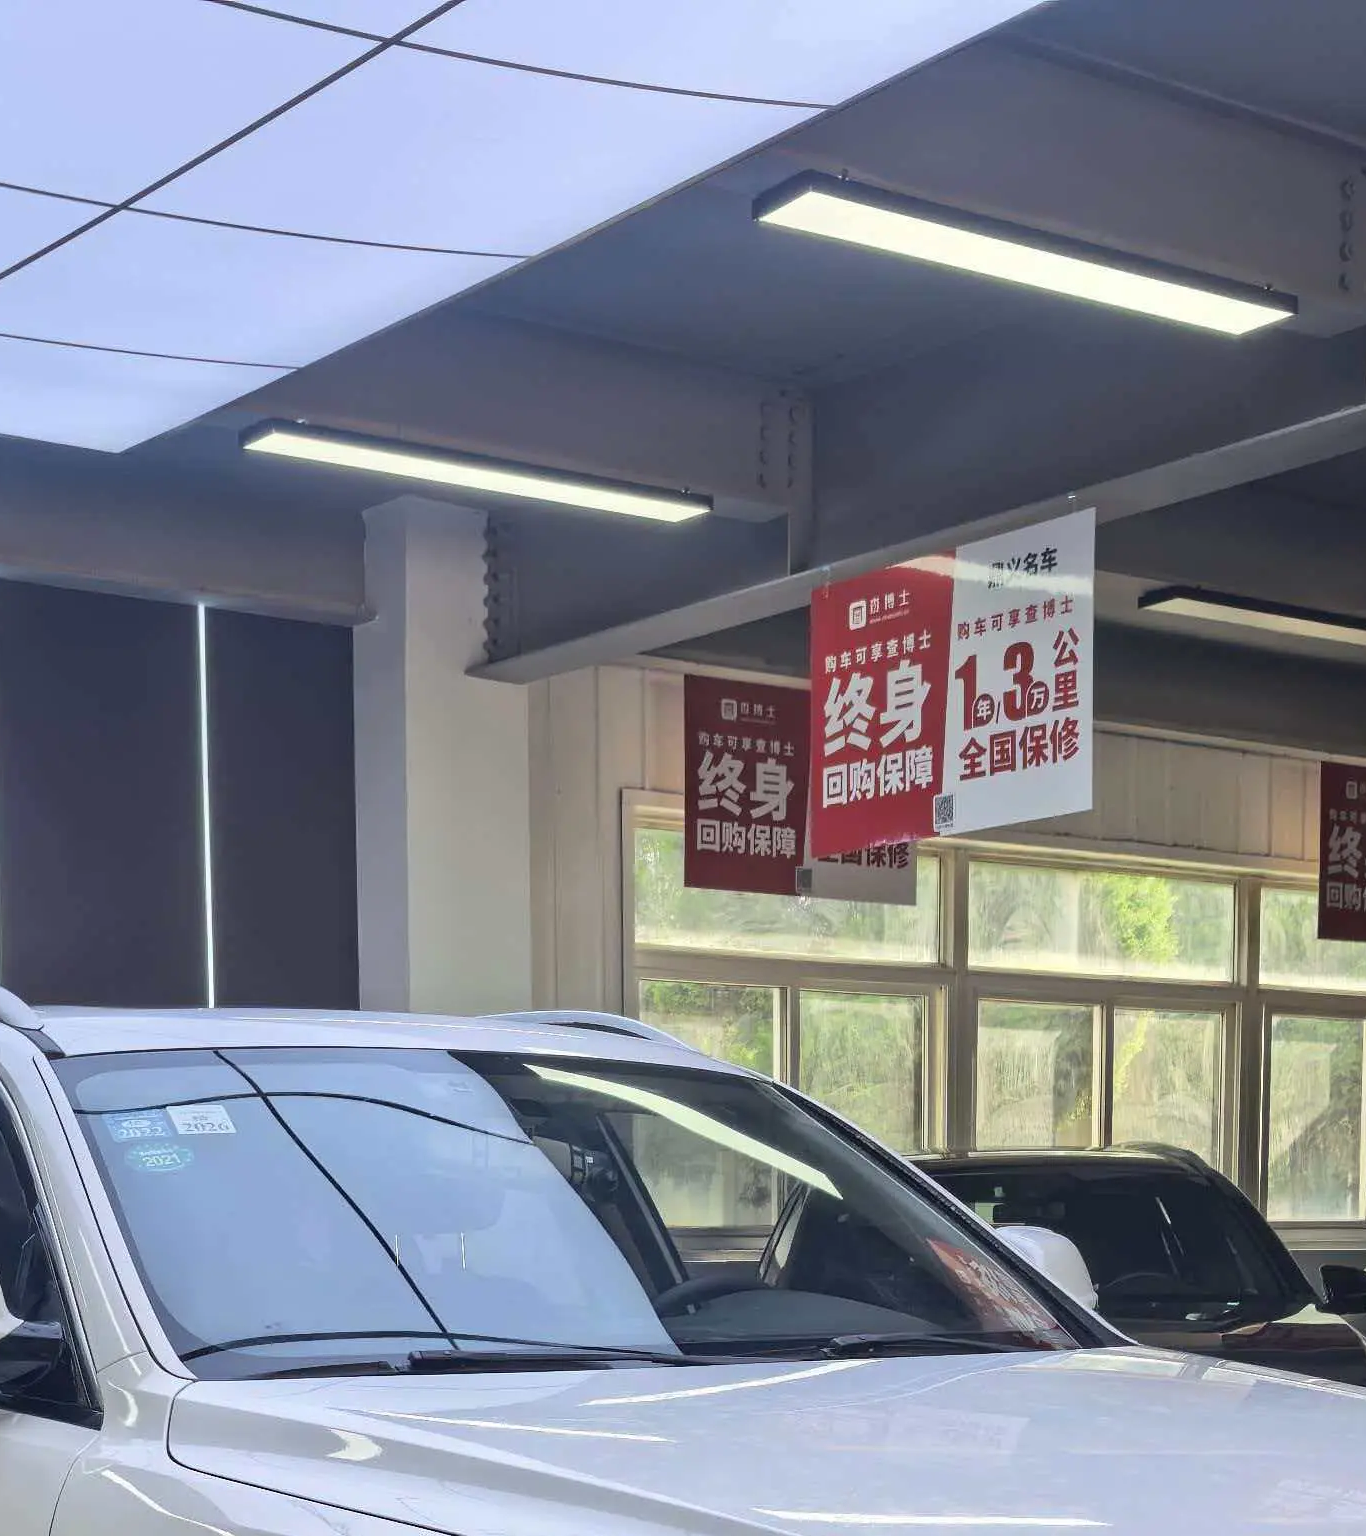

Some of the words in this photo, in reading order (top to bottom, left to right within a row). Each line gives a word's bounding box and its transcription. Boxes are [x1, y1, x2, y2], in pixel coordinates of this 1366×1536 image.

[957, 596, 1074, 640] 购车可享查博士
[825, 629, 931, 674] 购车可享查博士
[823, 659, 931, 756] 终身
[959, 717, 1080, 781] 全国保修
[697, 750, 795, 822] 终身
[822, 745, 934, 808] 回购保障
[697, 818, 796, 860] 回购保障
[818, 842, 910, 869] 保修
[142, 1153, 182, 1167] 2021
